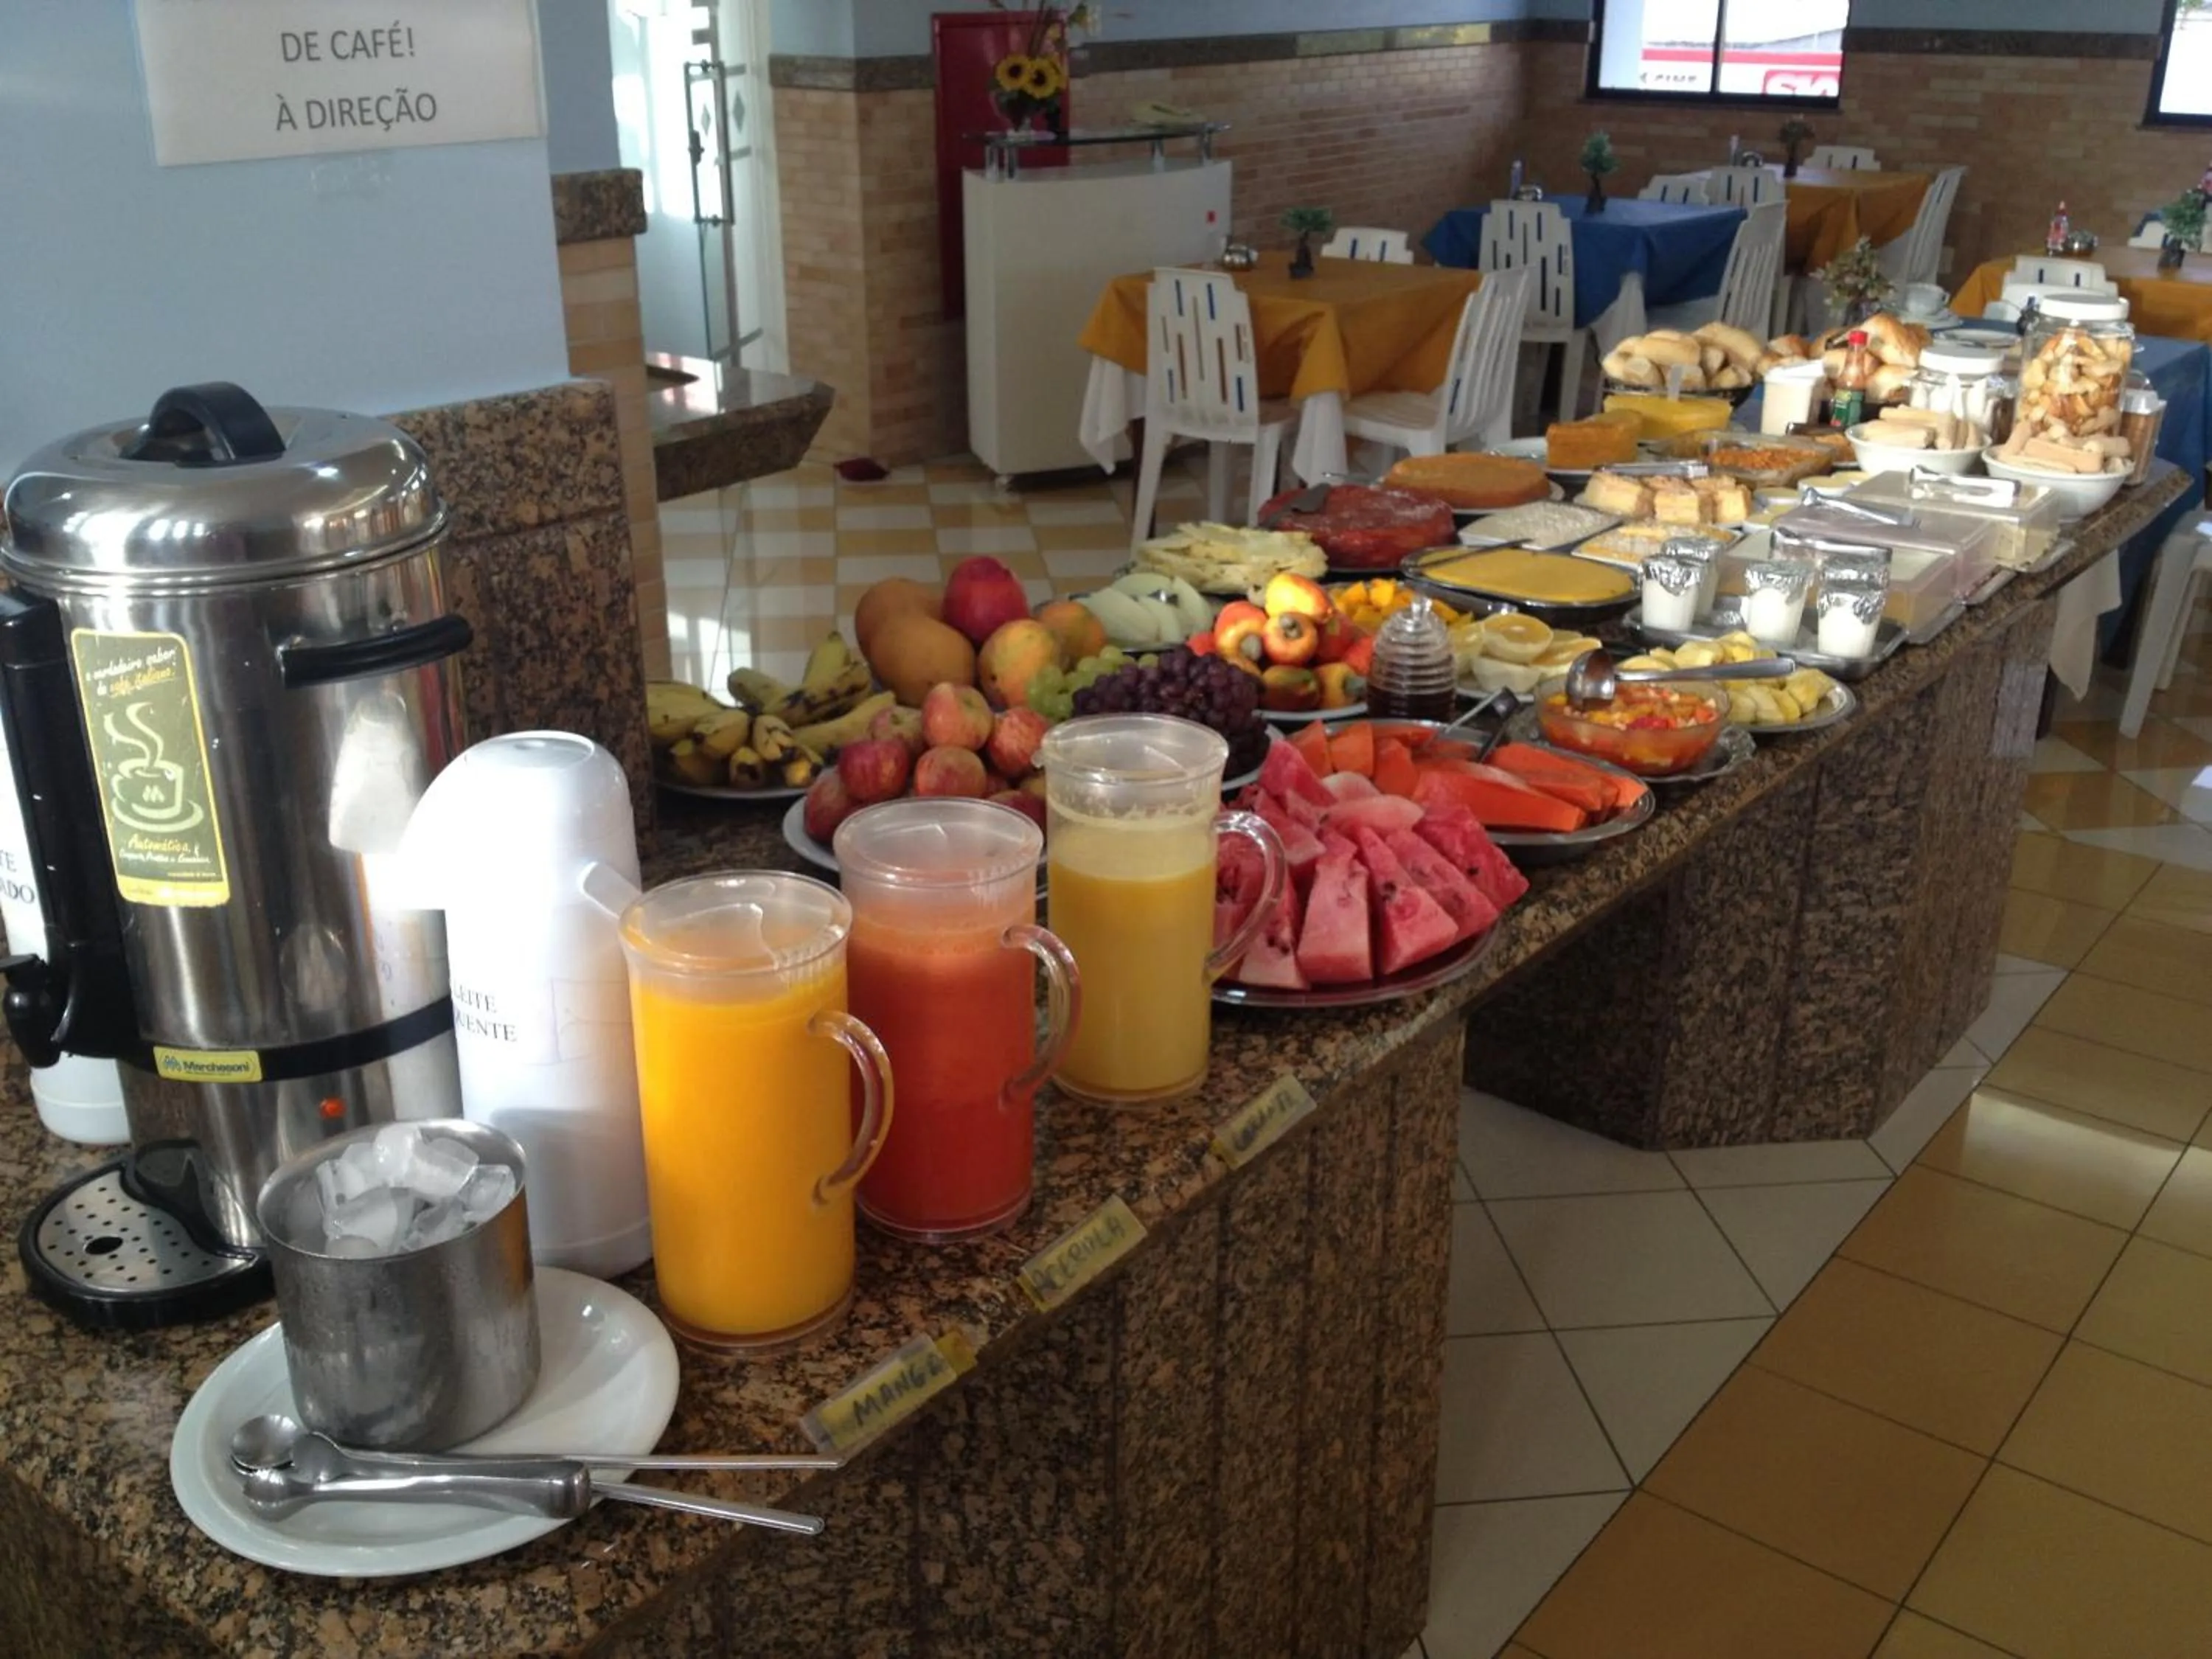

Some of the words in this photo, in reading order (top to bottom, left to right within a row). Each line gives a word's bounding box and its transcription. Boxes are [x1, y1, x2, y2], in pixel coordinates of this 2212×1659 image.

[280, 31, 321, 63] DE
[330, 19, 415, 60] CAFÉ!
[276, 93, 298, 131] À
[305, 87, 437, 132] DIREÇÃO
[453, 979, 498, 1014] LEITE
[454, 1007, 518, 1043] UENTE
